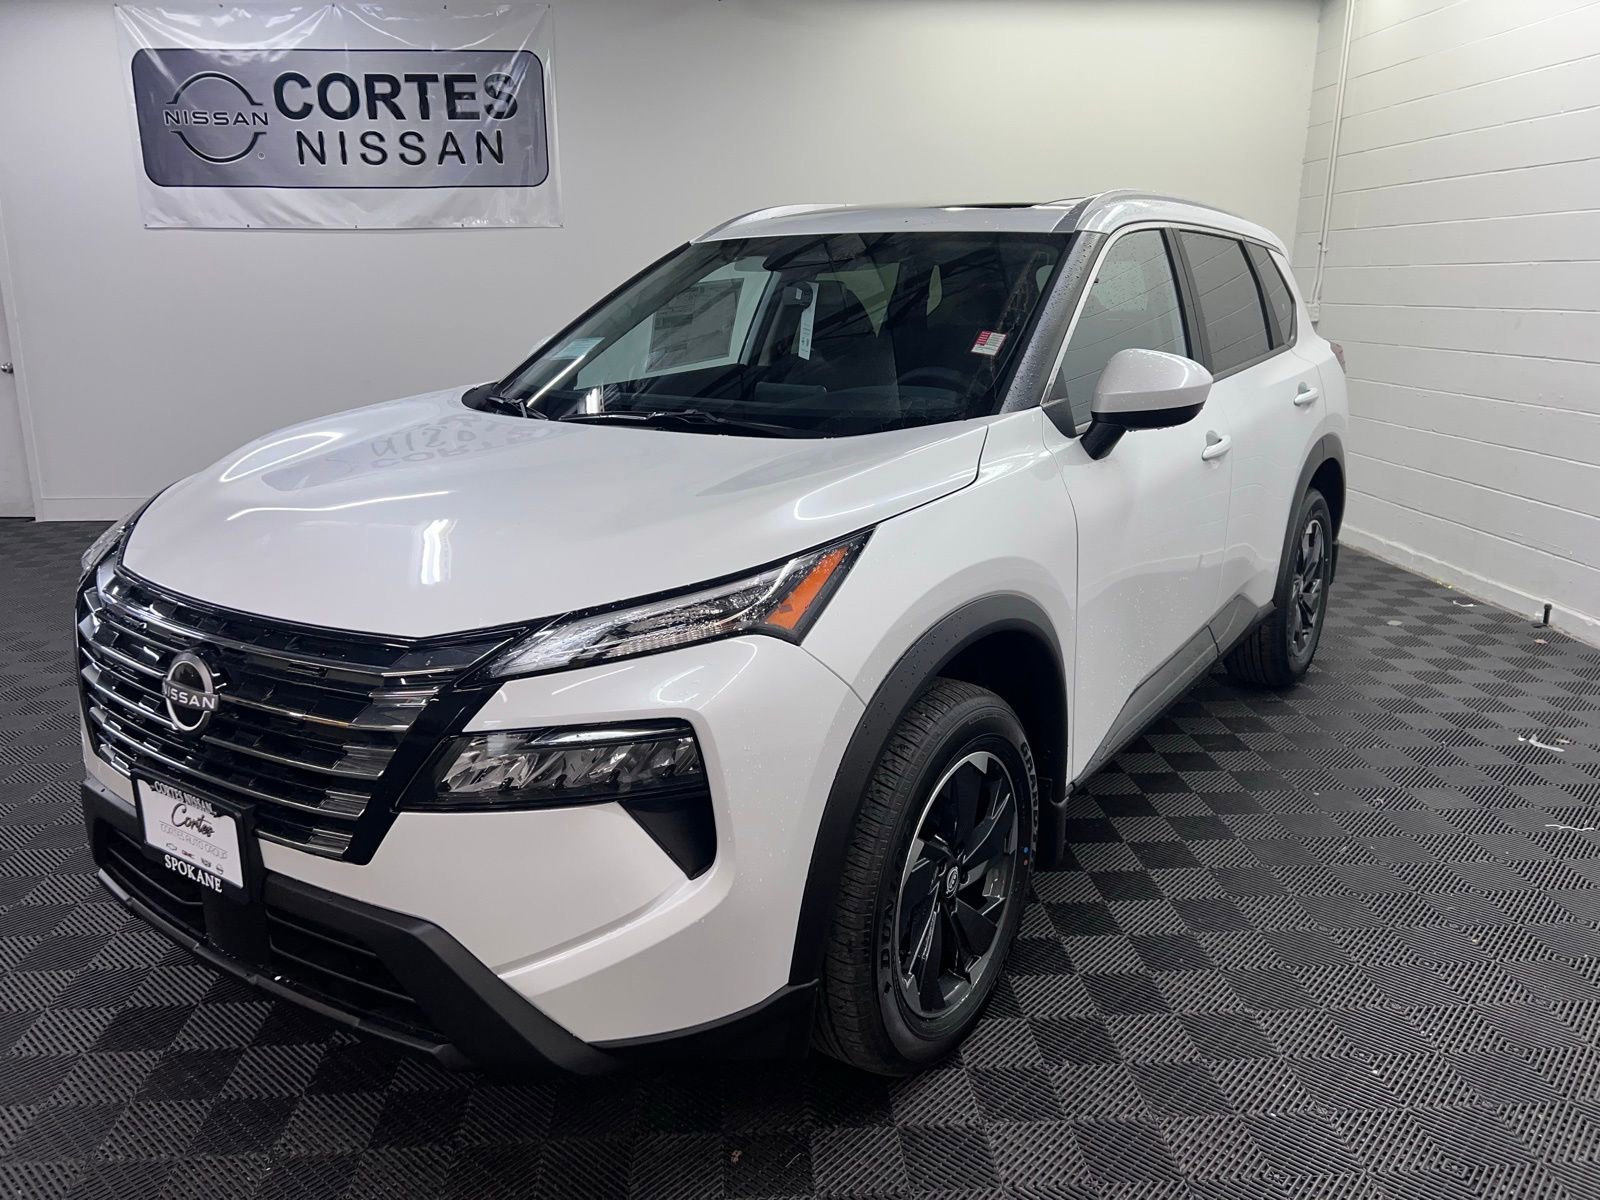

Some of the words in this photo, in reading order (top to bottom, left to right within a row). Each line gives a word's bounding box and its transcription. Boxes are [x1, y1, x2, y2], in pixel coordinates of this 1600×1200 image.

[273, 71, 519, 121] CORTES
[164, 110, 269, 126] NISSAN
[296, 130, 505, 165] NISSAN
[164, 854, 223, 893] SPOKANE
